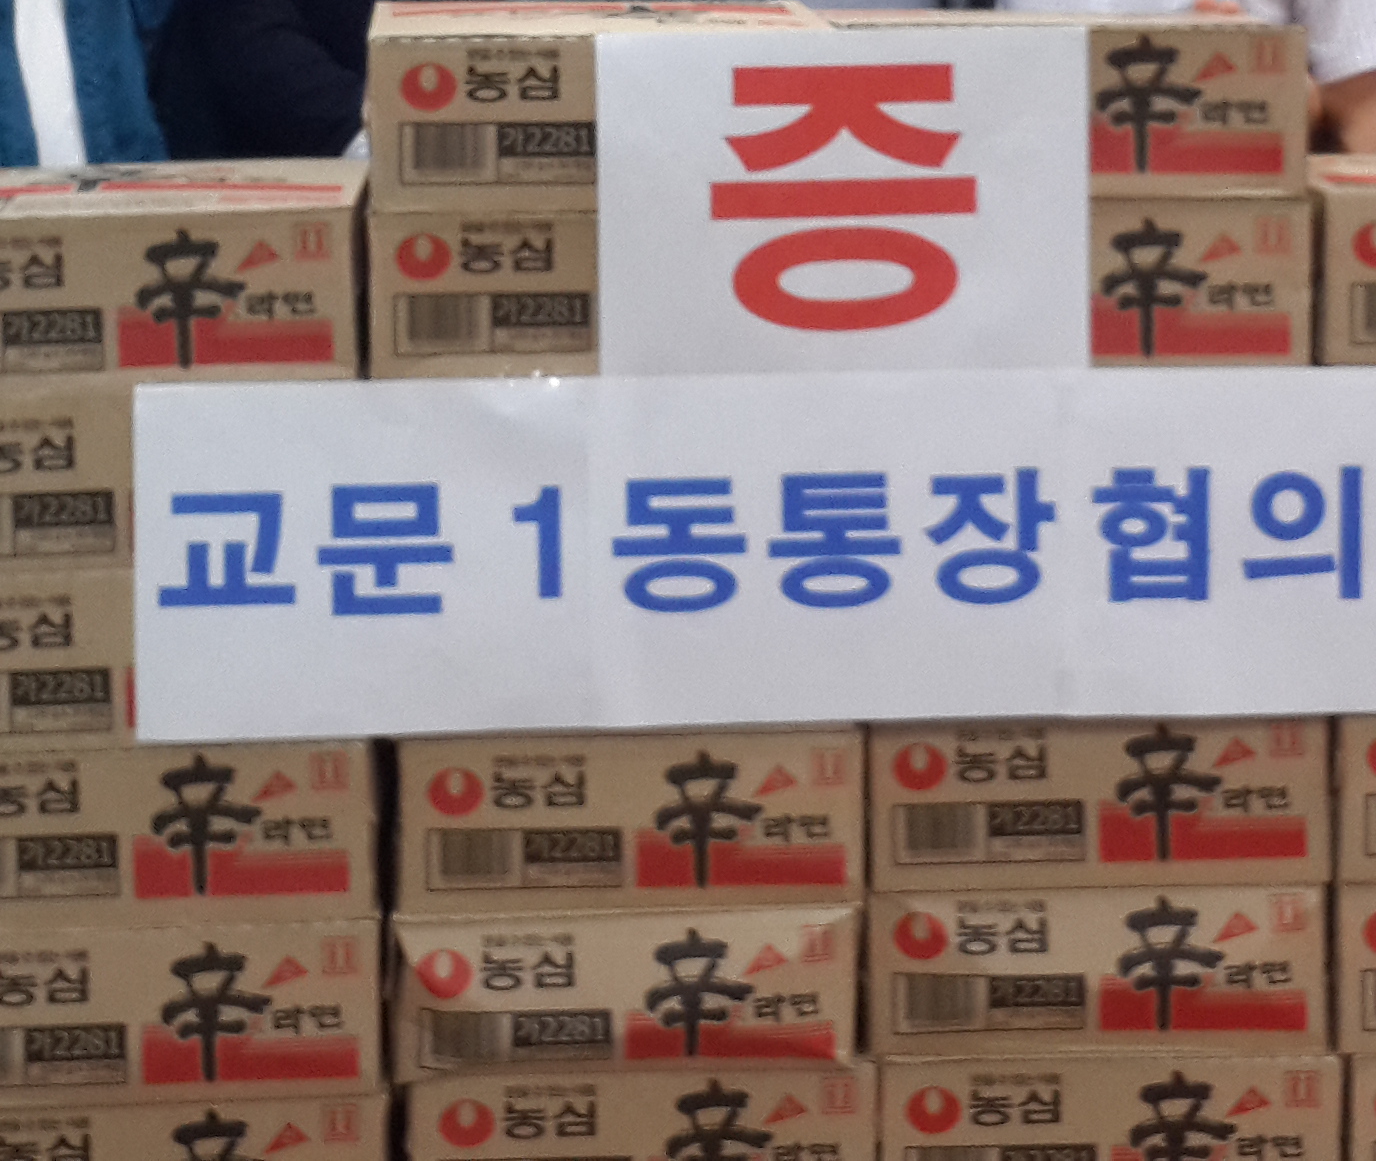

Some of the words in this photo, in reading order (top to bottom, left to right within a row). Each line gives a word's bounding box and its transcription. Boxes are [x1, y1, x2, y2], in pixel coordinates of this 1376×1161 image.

[465, 64, 561, 103] 농심
[1096, 34, 1203, 174] 辛
[460, 237, 555, 274] 농심
[710, 61, 978, 331] 증
[137, 229, 245, 369] 辛
[1100, 216, 1209, 357] 辛
[152, 752, 262, 896] 辛
[492, 771, 587, 809] 농심
[655, 750, 764, 889] 辛
[954, 744, 1048, 783] 농심
[1118, 722, 1223, 861] 辛
[482, 950, 575, 991] 농심
[644, 927, 755, 1057] 辛
[956, 916, 1049, 955] 농심
[1119, 895, 1225, 1031] 辛
[161, 940, 272, 1083] 辛
[504, 1101, 598, 1139] 농심
[969, 1089, 1062, 1126] 농심
